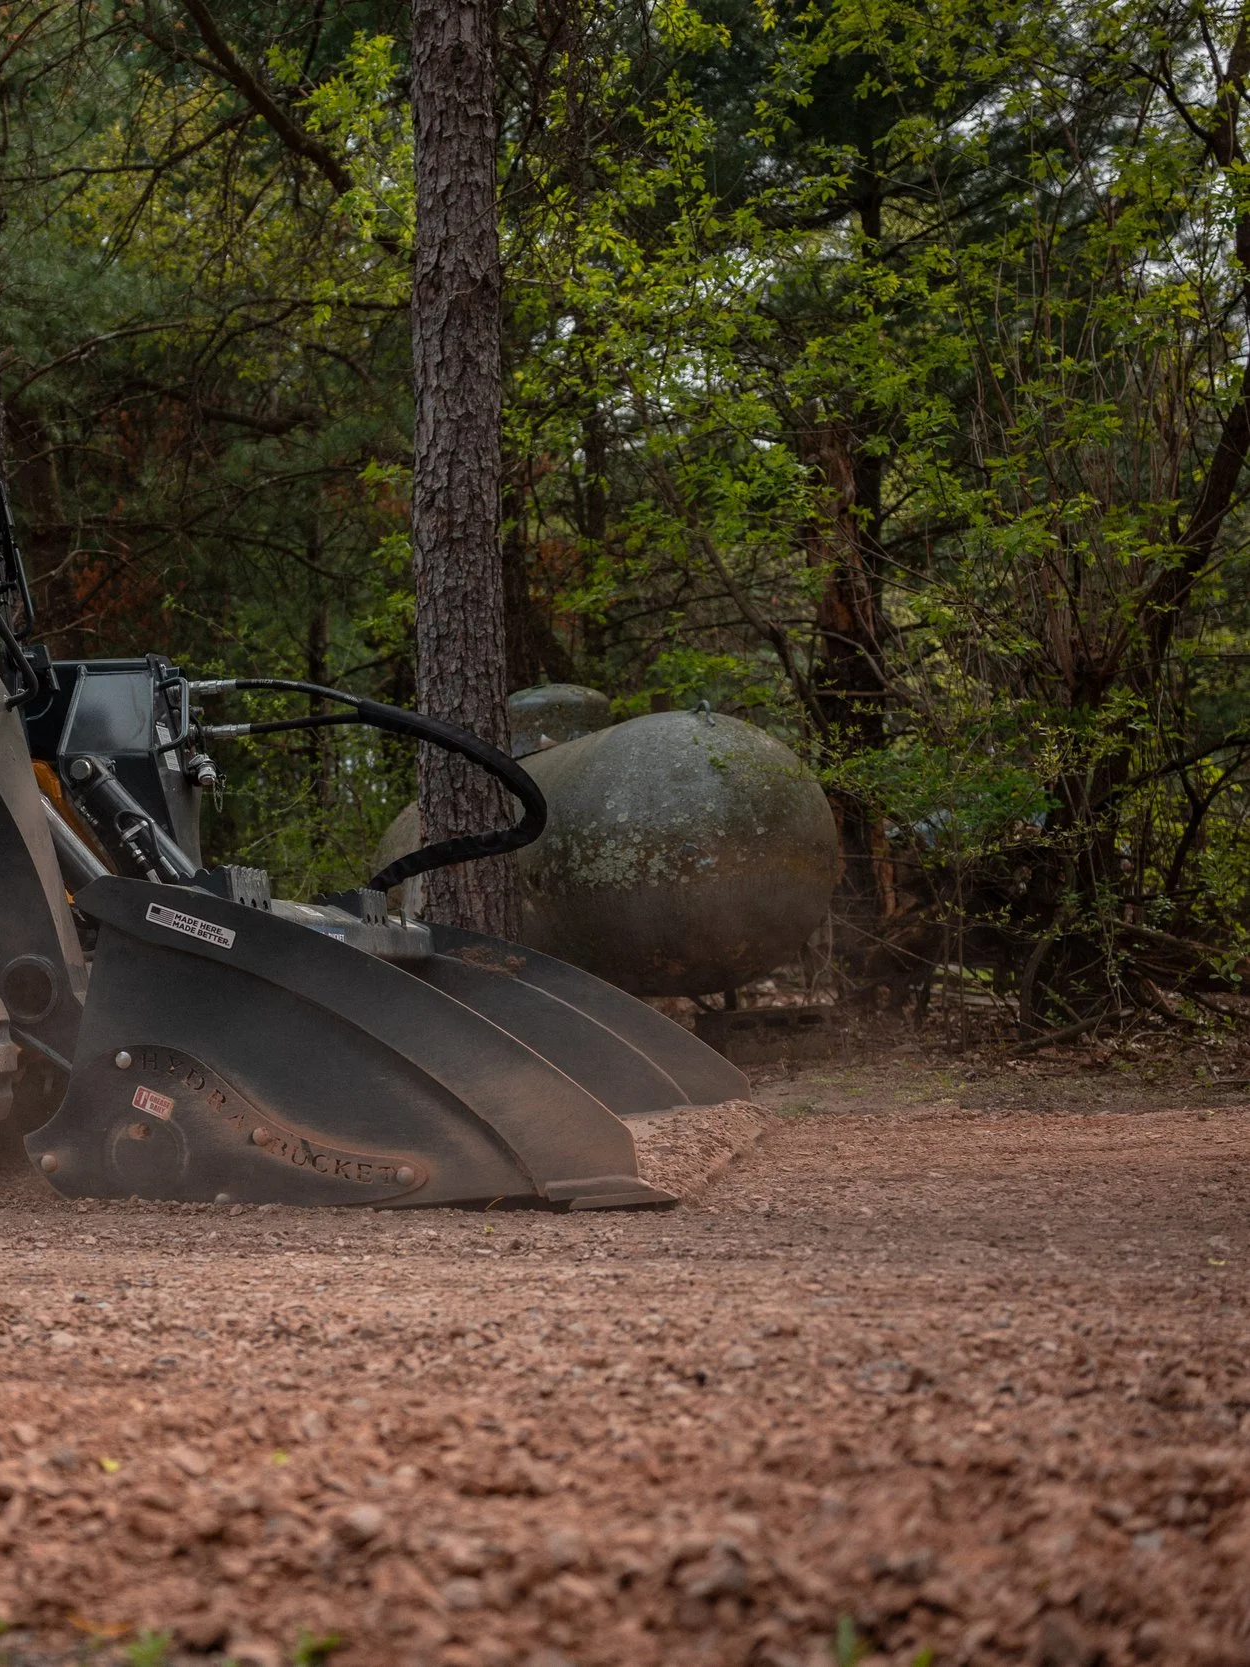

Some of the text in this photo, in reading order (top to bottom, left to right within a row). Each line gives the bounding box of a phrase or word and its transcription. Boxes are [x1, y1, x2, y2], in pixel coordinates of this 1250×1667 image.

[172, 921, 230, 946] MADE BETTER.
[174, 914, 224, 936] MADE HERE.
[141, 1051, 396, 1187] HYDRA BUCKET
[149, 1102, 165, 1114] DAILY
